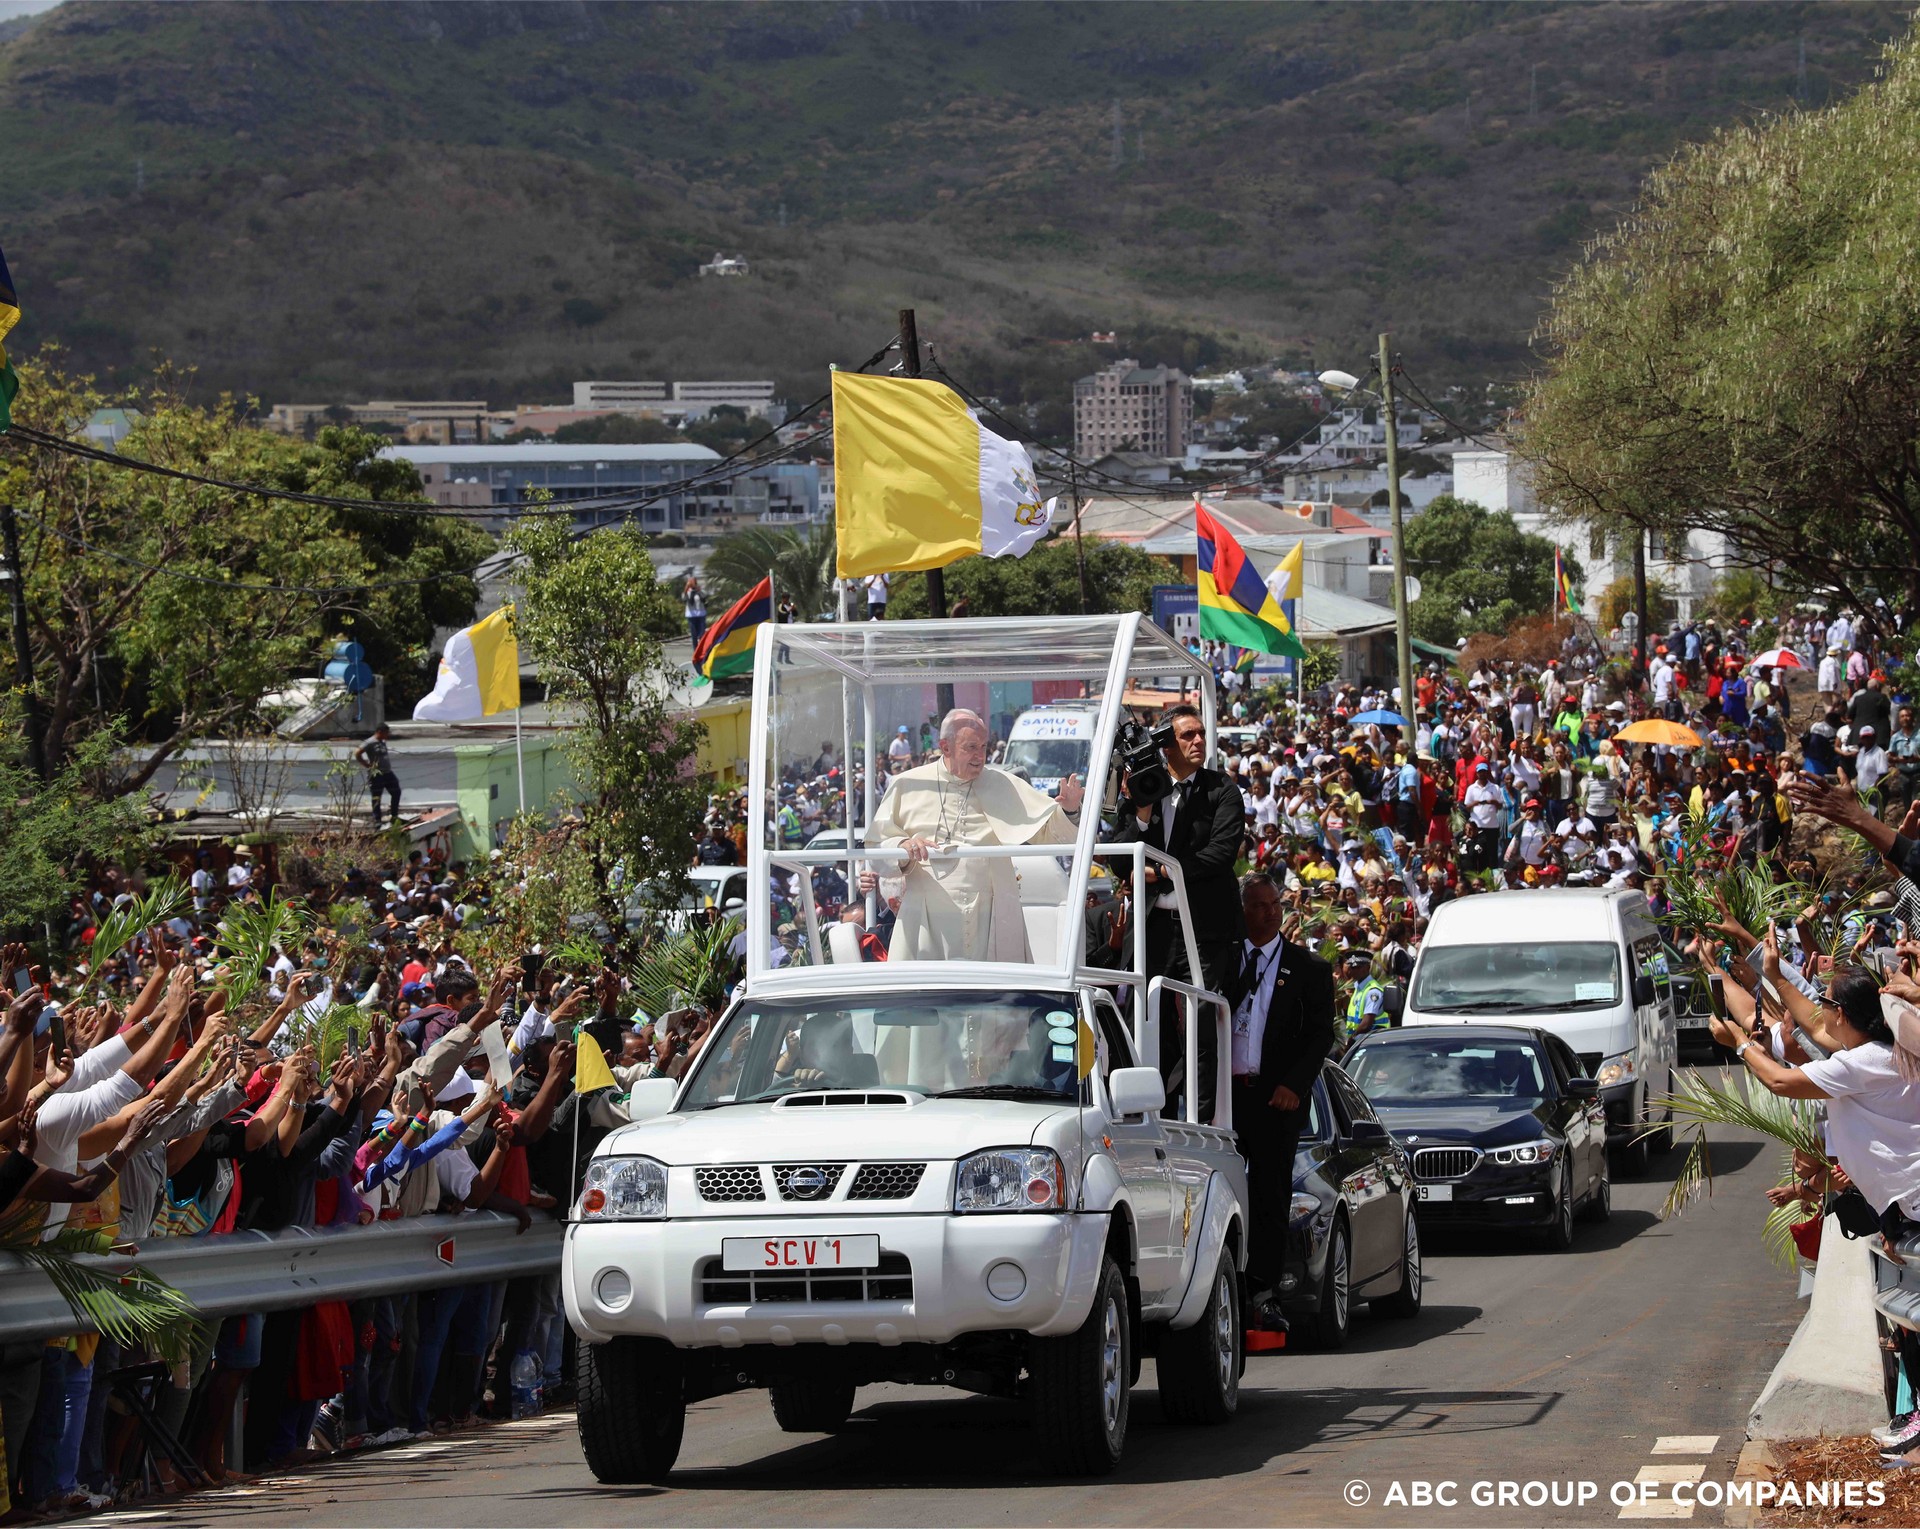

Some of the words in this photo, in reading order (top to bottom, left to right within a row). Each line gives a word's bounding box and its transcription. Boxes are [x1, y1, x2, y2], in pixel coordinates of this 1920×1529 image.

[1022, 718, 1065, 726] SAMU
[1057, 727, 1077, 736] 114
[832, 1239, 841, 1265] 1
